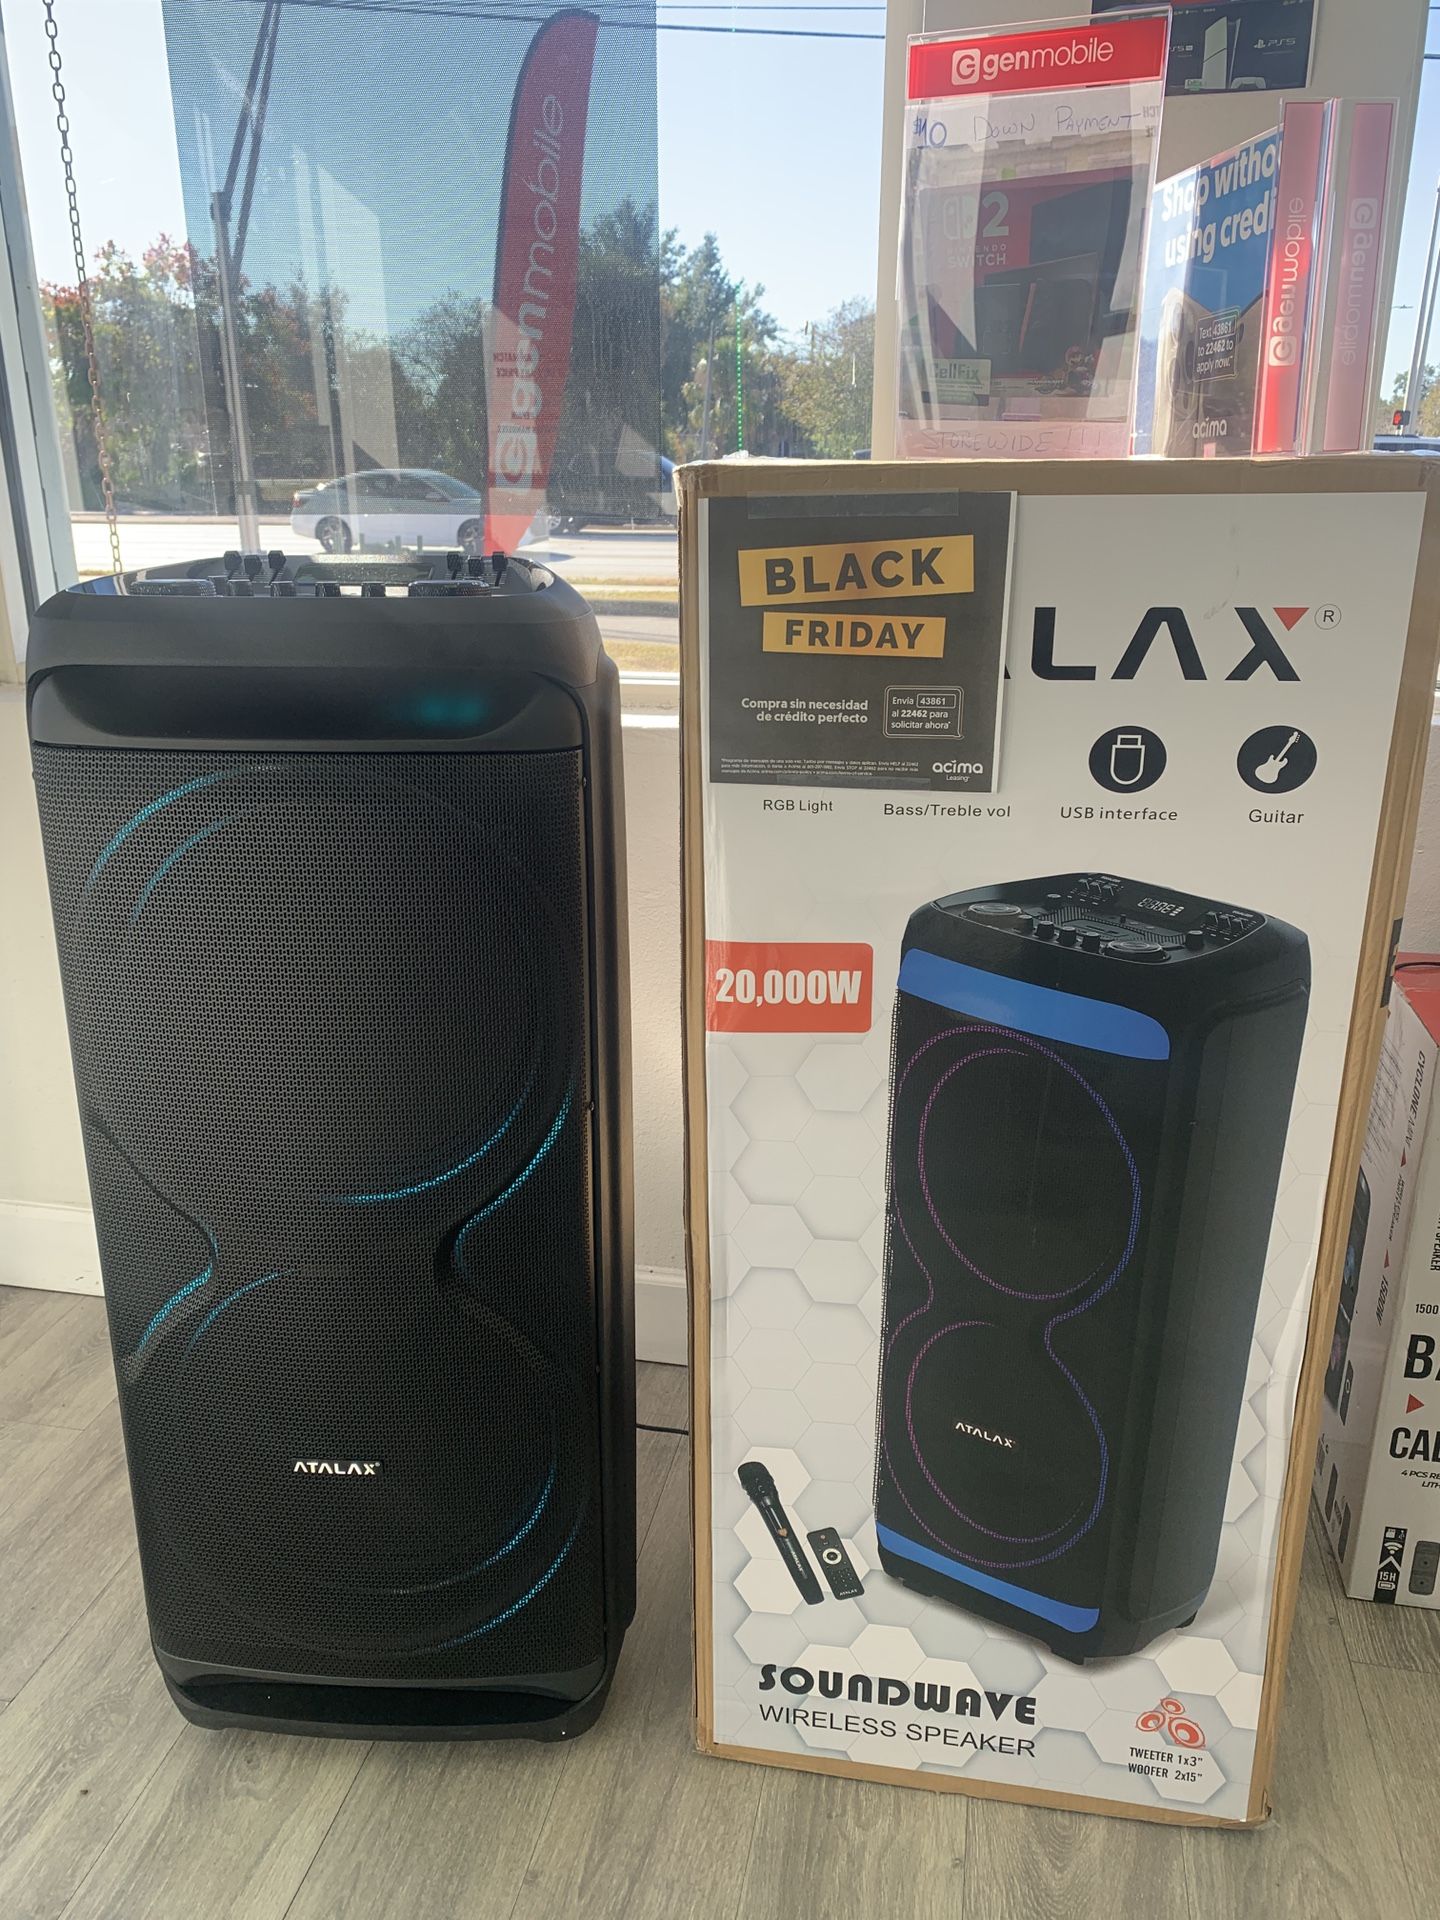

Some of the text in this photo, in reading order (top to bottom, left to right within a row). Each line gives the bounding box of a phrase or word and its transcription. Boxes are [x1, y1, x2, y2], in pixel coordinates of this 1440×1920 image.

[983, 37, 1114, 80] genmobile
[1161, 174, 1210, 222] Shop
[982, 191, 1009, 238] 2
[1164, 221, 1216, 264] using
[1198, 346, 1205, 357] to
[1226, 340, 1234, 351] to
[1196, 358, 1215, 375] apply
[1192, 416, 1228, 439] acima
[765, 546, 945, 596] BLACK
[785, 619, 925, 650] FRIDAY
[741, 697, 868, 711] Compra sin necesidad
[920, 697, 946, 706] 43861
[756, 711, 868, 725] de crédito perfecto
[891, 709, 949, 720] al 22462 para
[891, 720, 923, 729] solicitar
[932, 759, 984, 774] acima
[763, 799, 833, 814] RGB Light
[883, 803, 1011, 817] Bass/Treble vol
[1060, 806, 1178, 821] USB interface
[1248, 808, 1304, 824] Guitar
[715, 967, 862, 1008] 20,000W
[955, 1421, 1015, 1449] ATALAX
[1389, 1426, 1440, 1463] CA
[293, 1461, 377, 1475] ATALAX
[1409, 1470, 1428, 1478] PCS
[758, 1663, 1037, 1726] SOUNDWAVE
[759, 1704, 1036, 1758] WIRELESS SPEAKER
[1129, 1746, 1174, 1763] TWEETER
[1128, 1762, 1169, 1778] WOOFER
